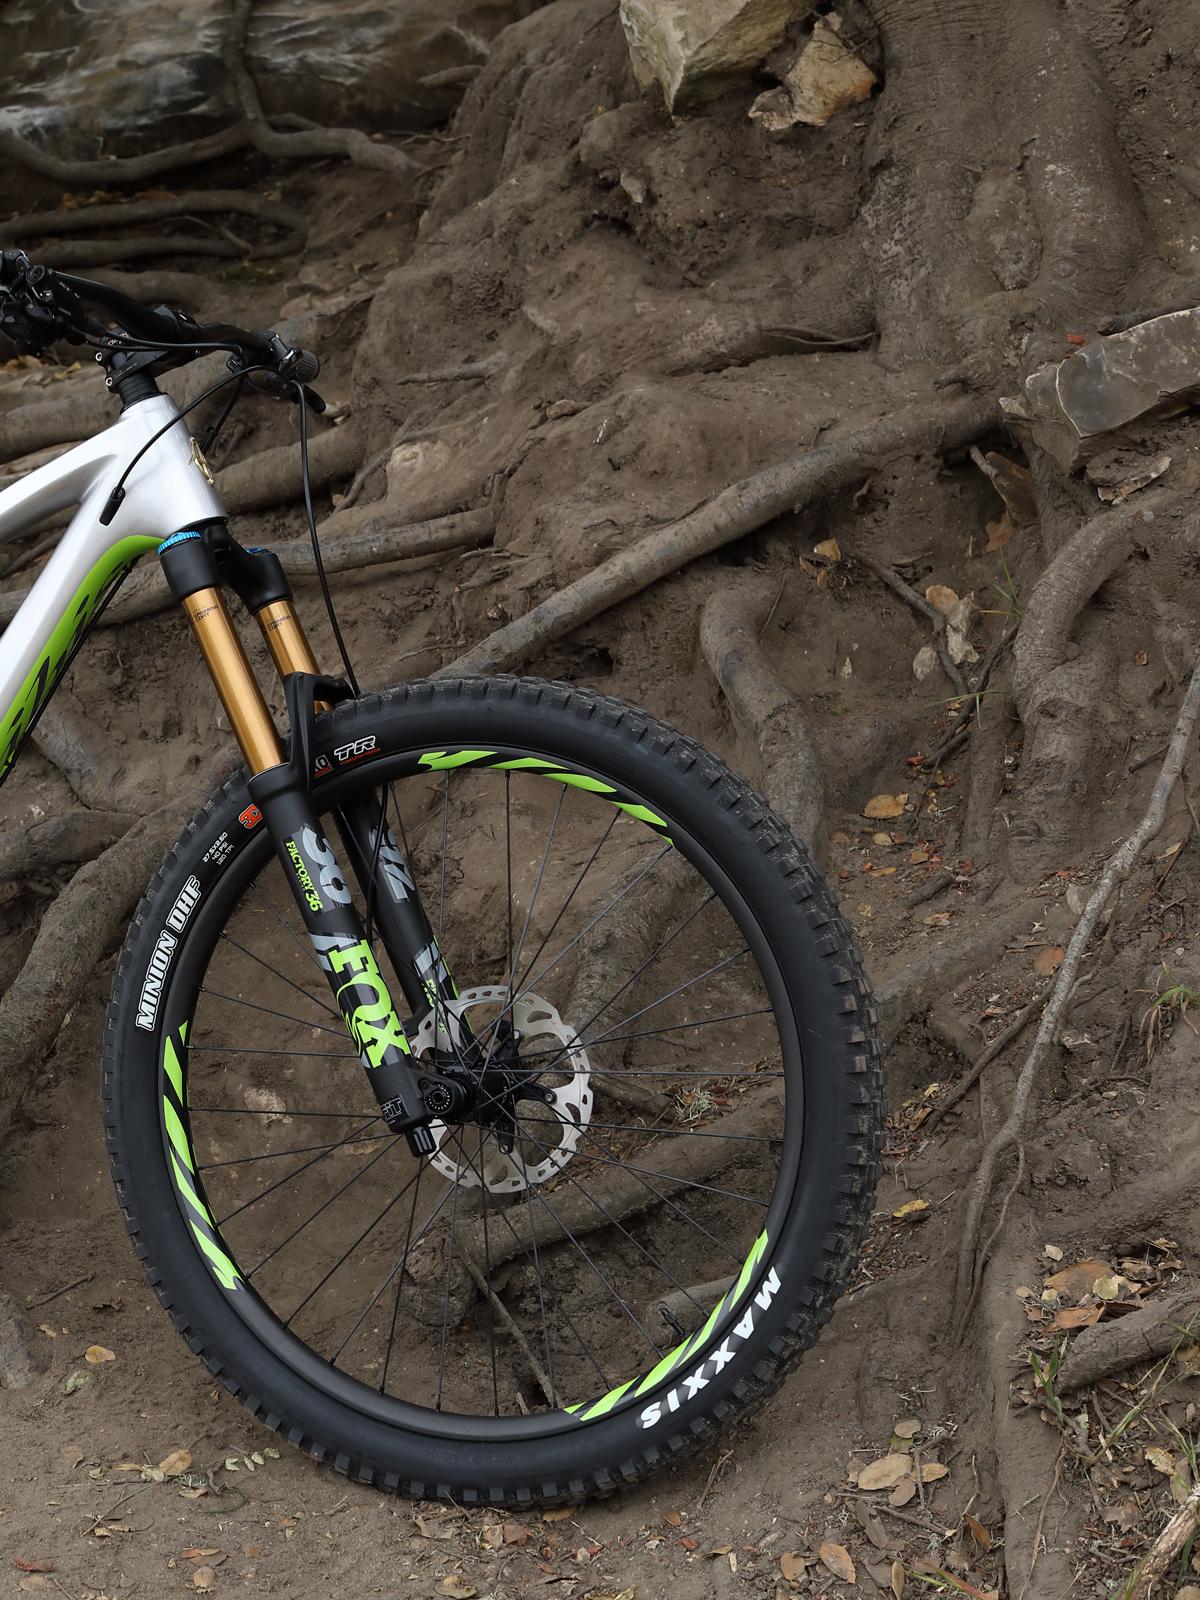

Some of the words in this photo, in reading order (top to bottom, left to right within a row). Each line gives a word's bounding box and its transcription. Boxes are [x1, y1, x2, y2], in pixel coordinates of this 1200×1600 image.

[334, 735, 376, 761] TR
[285, 840, 315, 891] FACTORY
[305, 890, 324, 912] 36
[136, 930, 179, 1032] MINION
[166, 874, 202, 933] DHF
[328, 938, 412, 1069] FOX
[640, 1266, 782, 1429] MAXXIS
